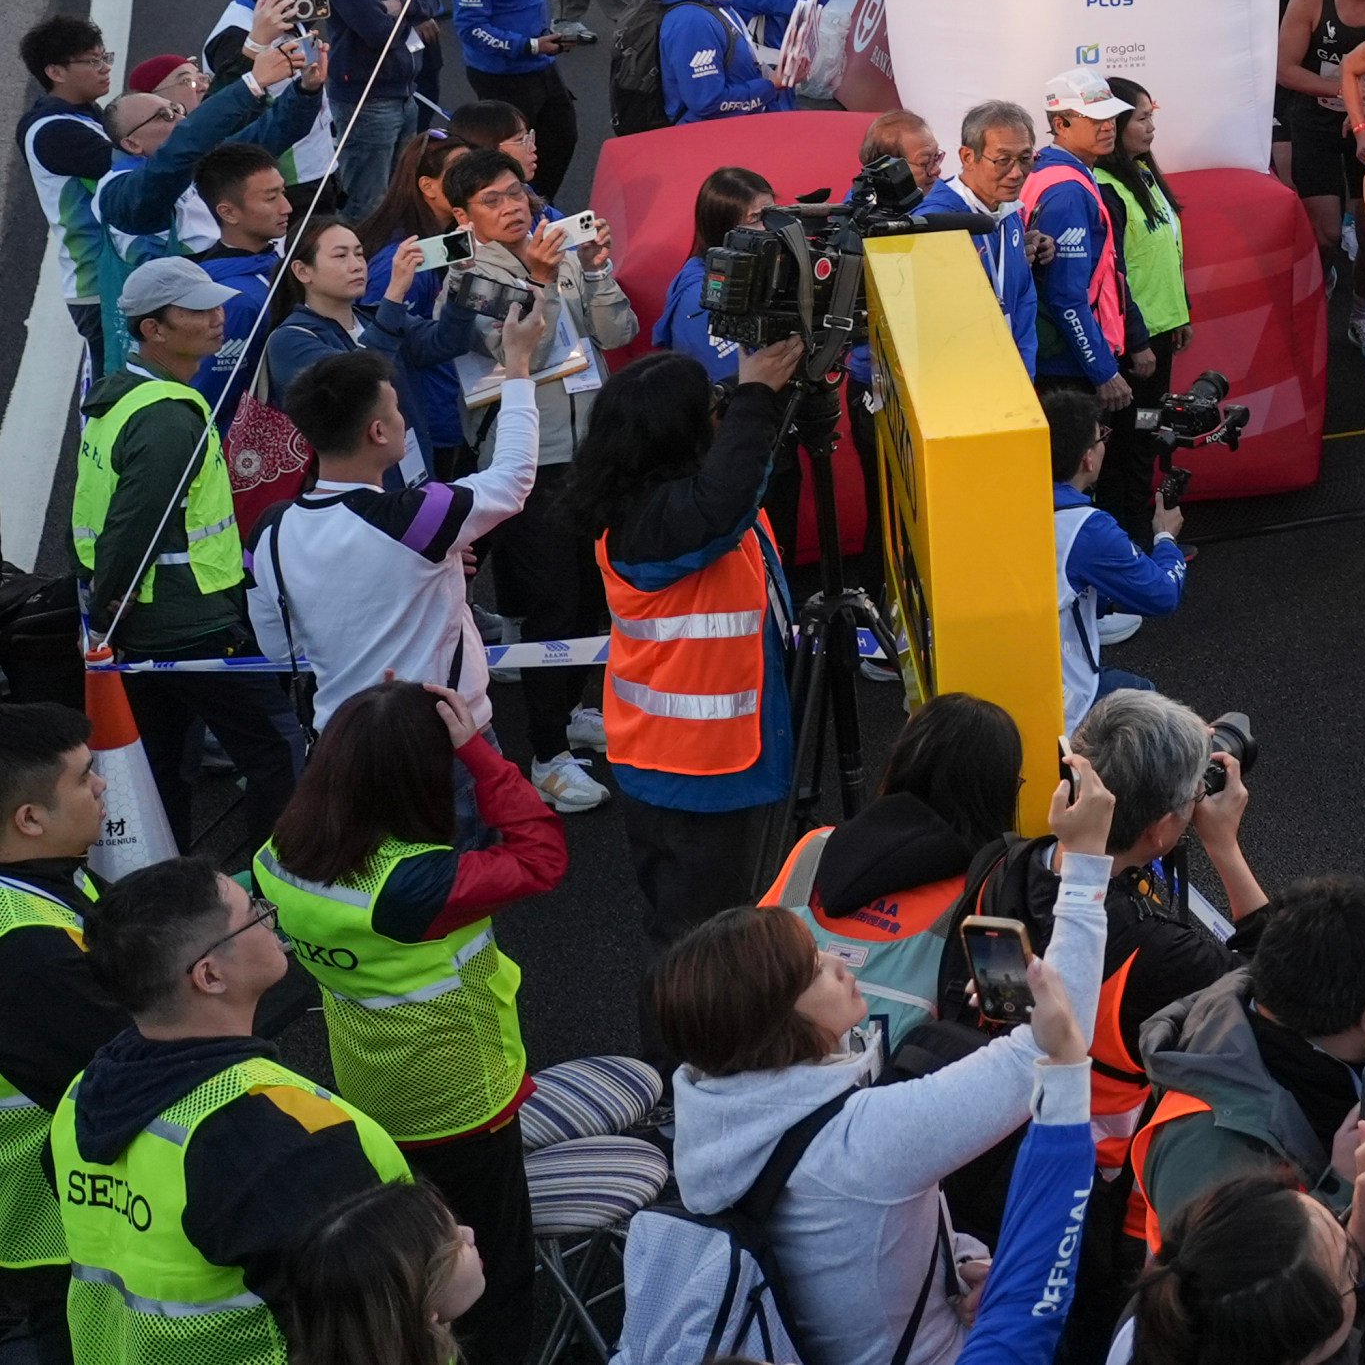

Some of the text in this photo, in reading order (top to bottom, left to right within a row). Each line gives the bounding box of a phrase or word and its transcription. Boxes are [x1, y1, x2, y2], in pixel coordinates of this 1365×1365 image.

[1106, 42, 1146, 56] regala
[1063, 308, 1096, 366] OFFICIAL
[107, 819, 126, 837] 材
[1032, 1174, 1094, 1319] OFFICIAL
